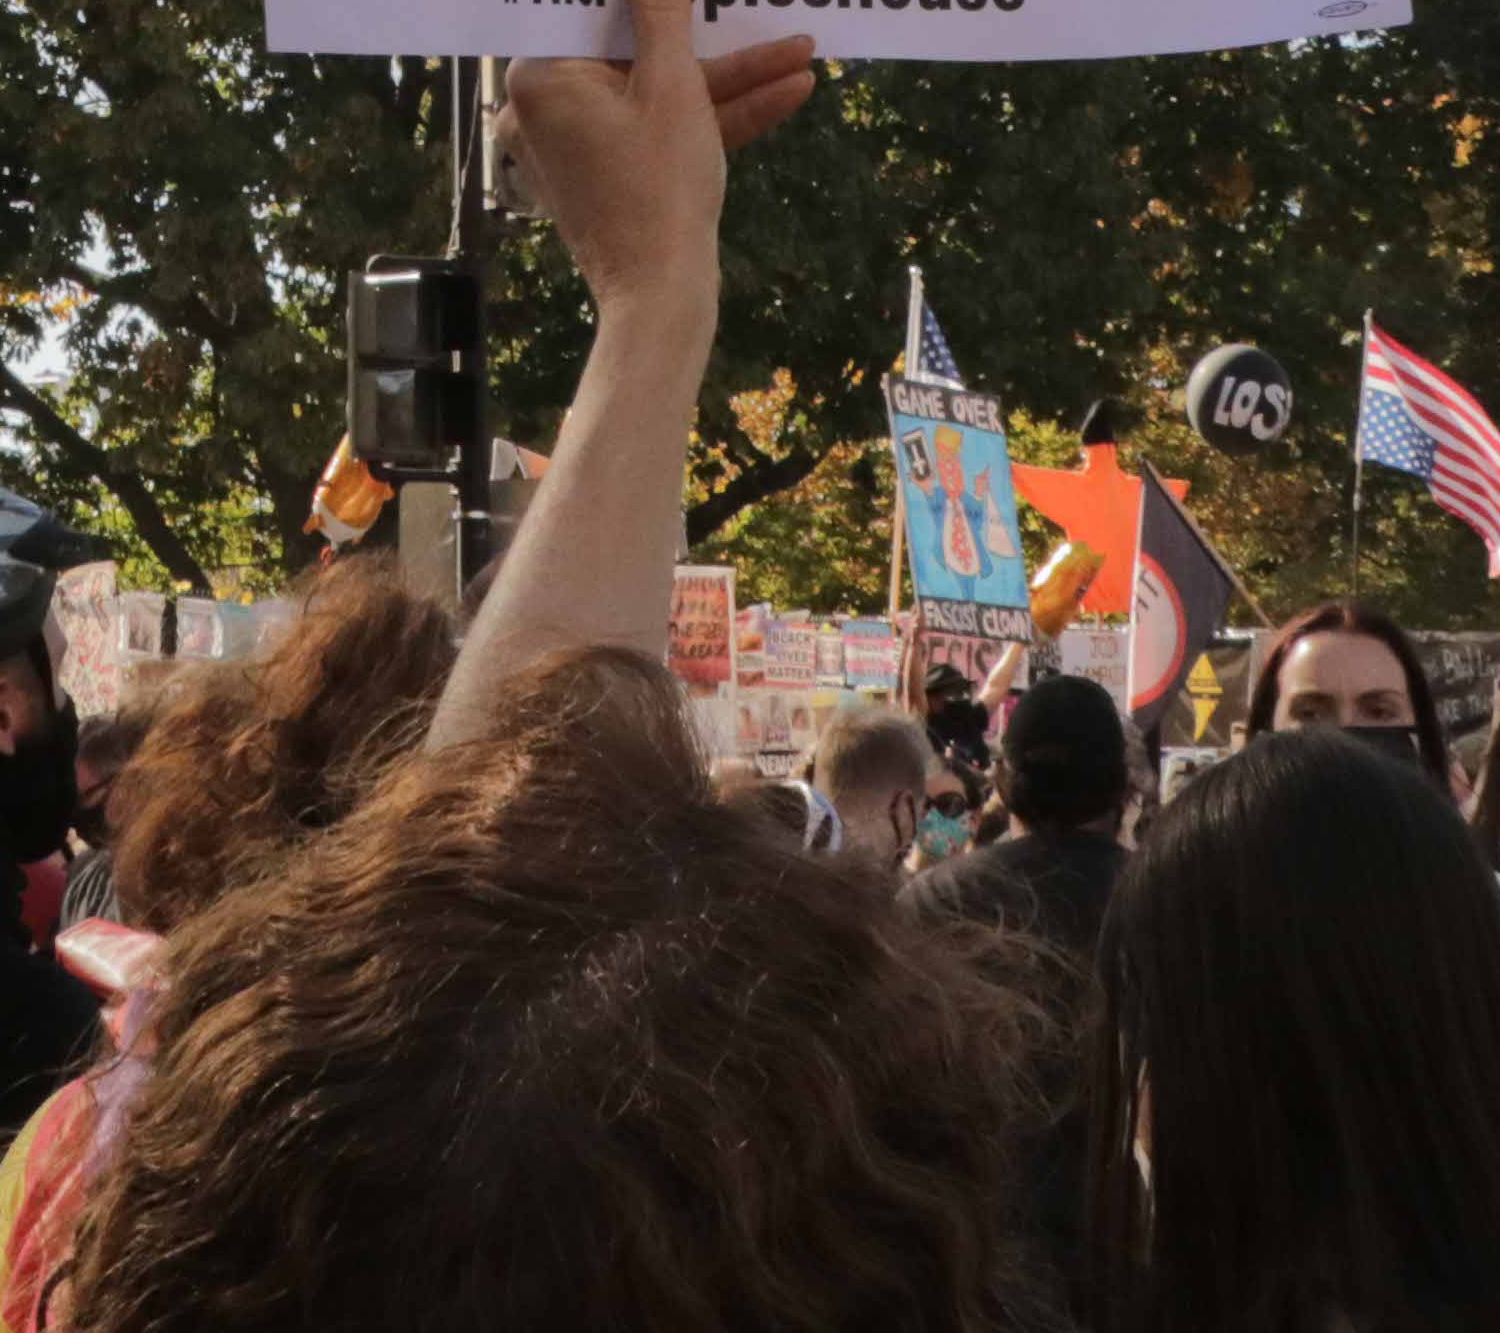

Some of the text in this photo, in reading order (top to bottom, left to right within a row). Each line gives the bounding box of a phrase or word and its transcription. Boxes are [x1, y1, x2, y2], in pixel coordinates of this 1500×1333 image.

[893, 383, 1005, 435] GAME OVER
[1213, 376, 1293, 441] LOS
[924, 600, 978, 631] FASCIST
